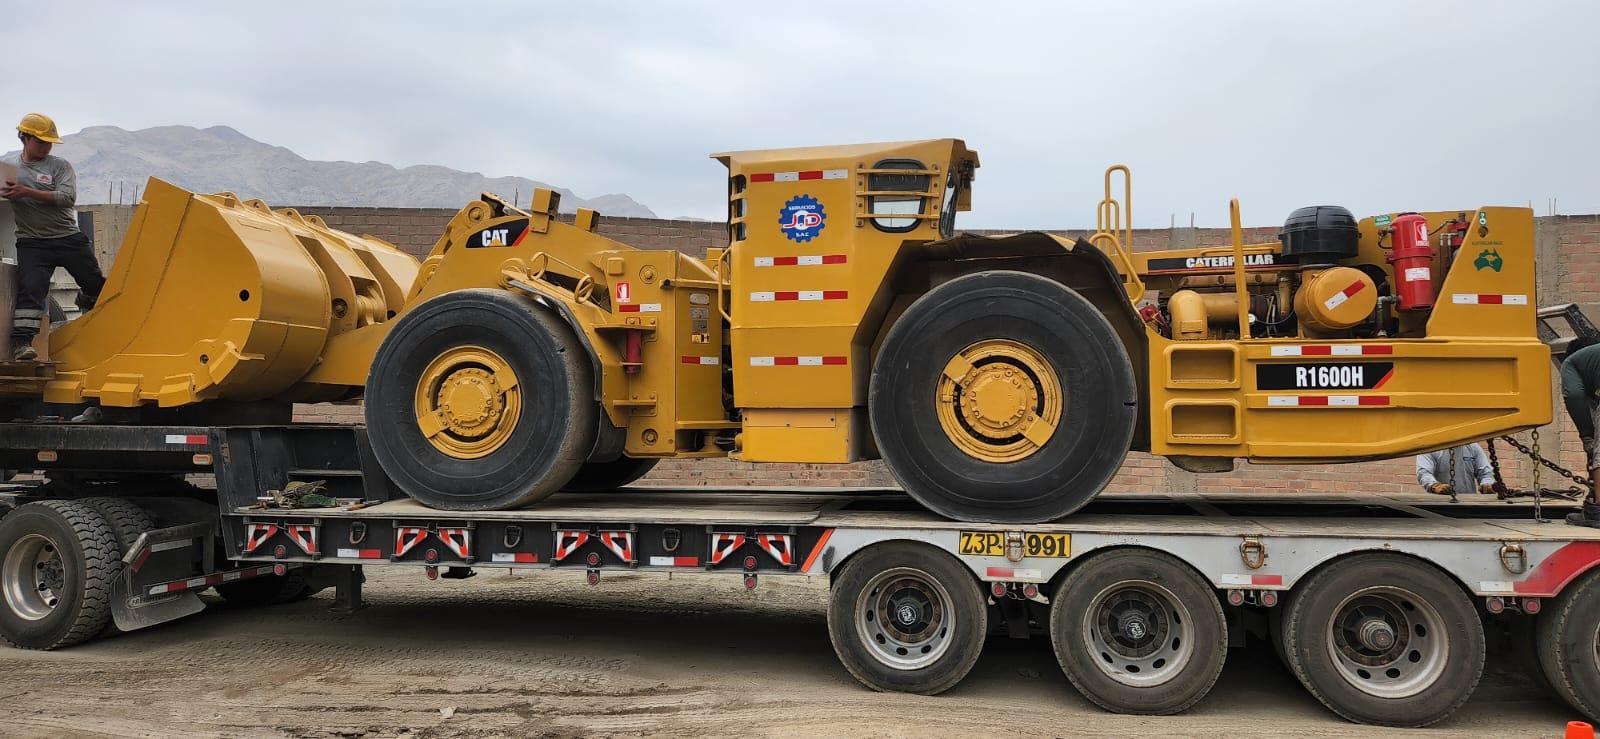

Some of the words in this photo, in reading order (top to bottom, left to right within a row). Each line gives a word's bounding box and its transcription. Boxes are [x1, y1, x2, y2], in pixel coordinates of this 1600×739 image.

[482, 229, 508, 247] CAT
[1186, 254, 1274, 268] CATERPLLAR
[1296, 366, 1364, 387] R1600H
